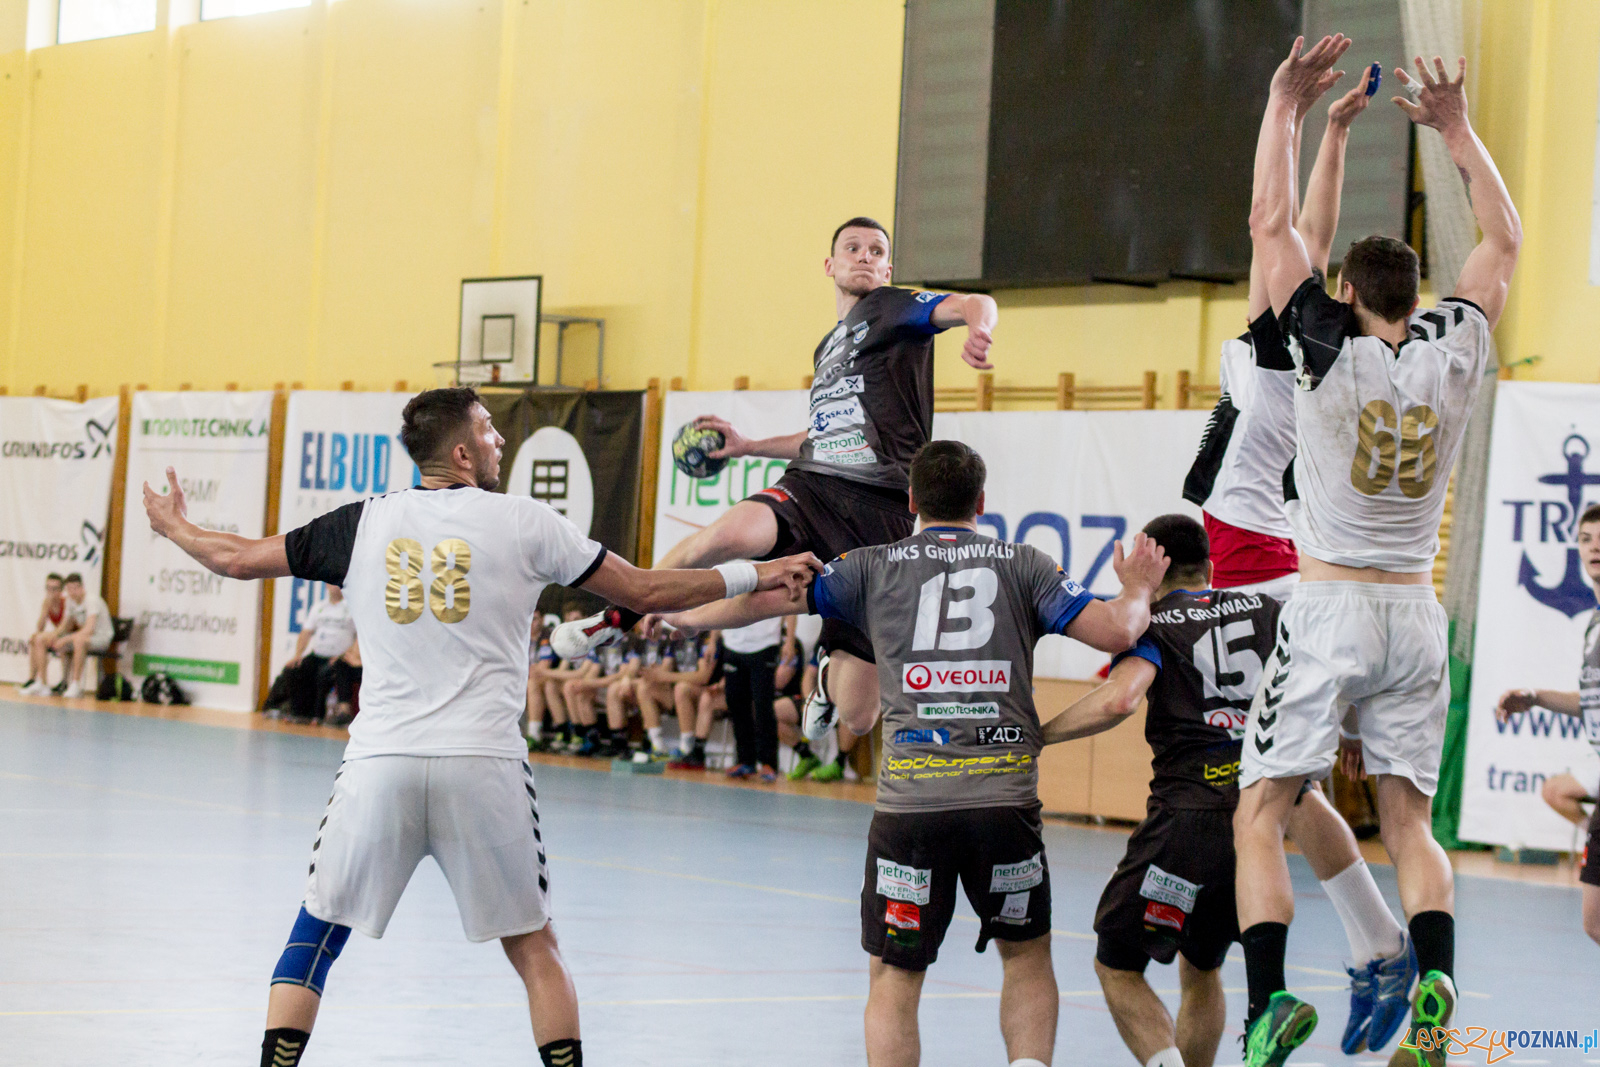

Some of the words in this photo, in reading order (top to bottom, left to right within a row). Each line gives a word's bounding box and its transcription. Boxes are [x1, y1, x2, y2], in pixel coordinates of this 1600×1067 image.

[2, 441, 85, 459] GRUNDFOS
[300, 432, 391, 493] ELBUD
[1350, 399, 1439, 499] 66
[888, 544, 920, 562] WKS
[384, 537, 472, 625] 88
[911, 566, 998, 651] 13
[1150, 608, 1186, 624] WKS
[936, 668, 1008, 685] VEOLIA
[1193, 618, 1263, 699] 15
[878, 864, 929, 885] netronik
